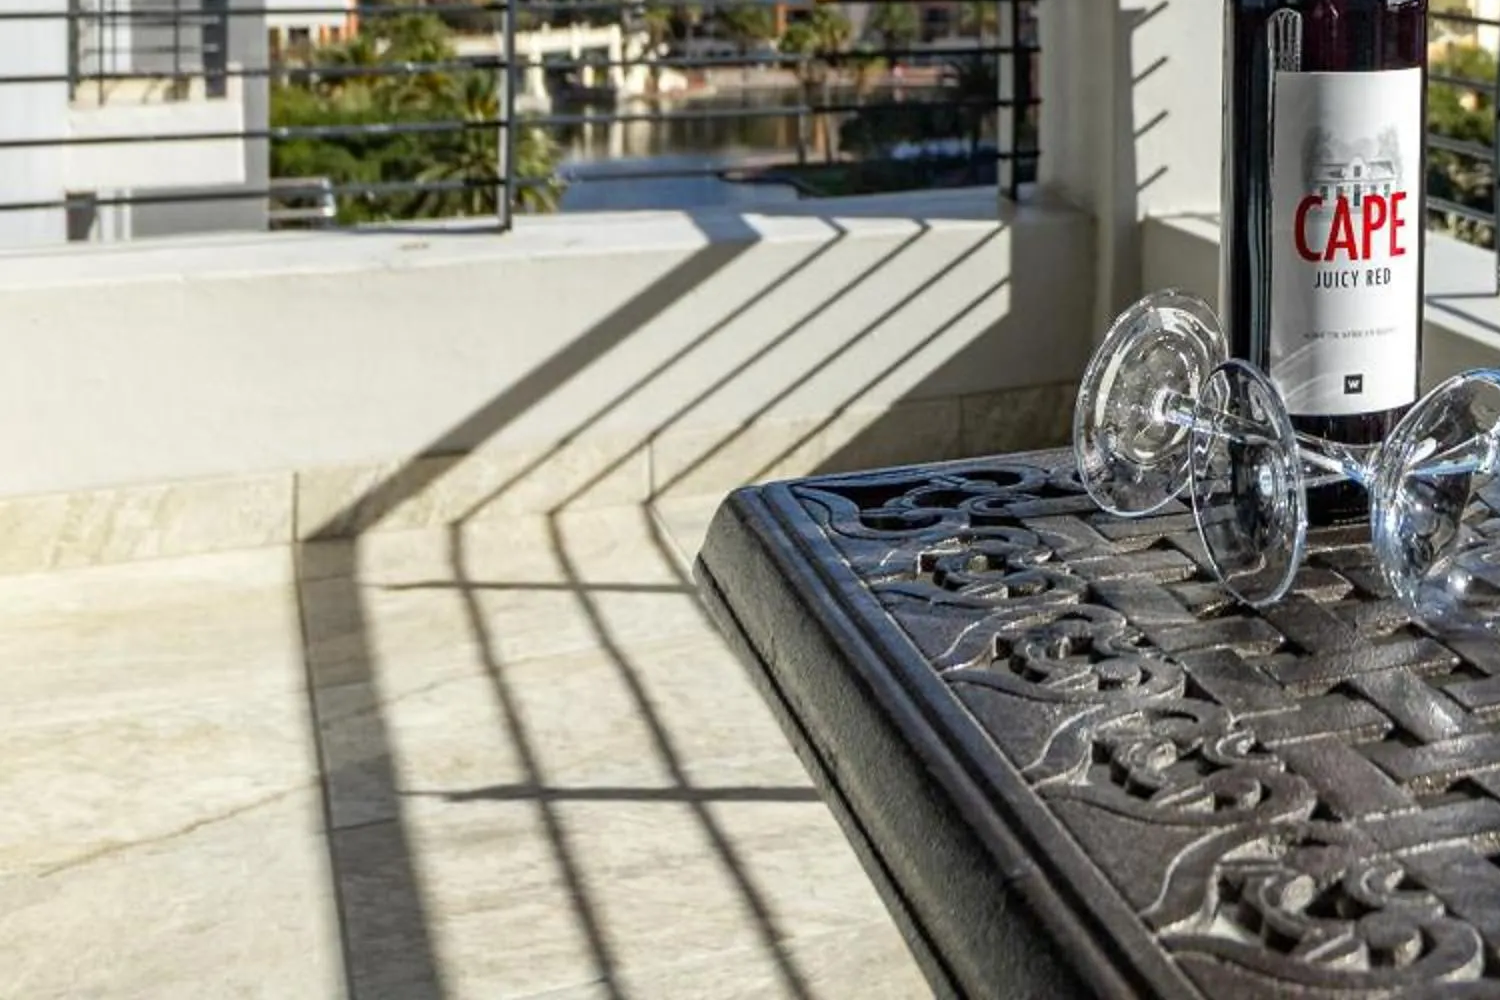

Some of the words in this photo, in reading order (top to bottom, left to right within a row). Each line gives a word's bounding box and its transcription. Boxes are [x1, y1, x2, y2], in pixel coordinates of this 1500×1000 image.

[1294, 191, 1407, 262] CAPE
[1314, 269, 1359, 289] JUICY
[1365, 267, 1391, 286] RED
